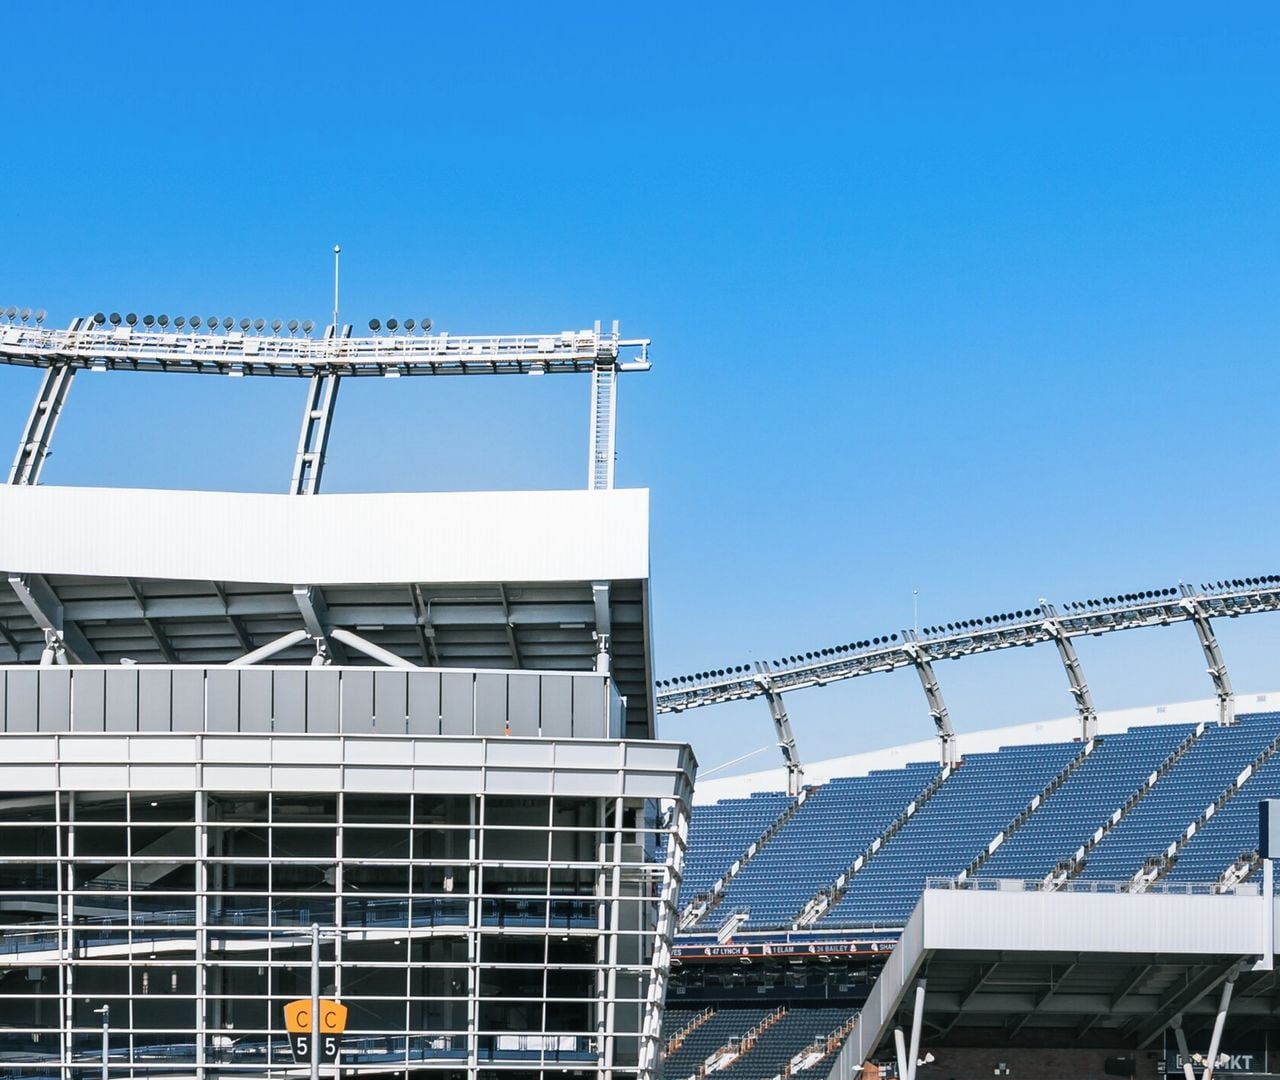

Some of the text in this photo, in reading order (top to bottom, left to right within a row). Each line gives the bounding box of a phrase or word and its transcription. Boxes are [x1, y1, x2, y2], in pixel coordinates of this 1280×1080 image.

[296, 1011, 308, 1028] C
[325, 1012, 336, 1028] C
[297, 1038, 308, 1055] 5
[325, 1038, 336, 1055] 5
